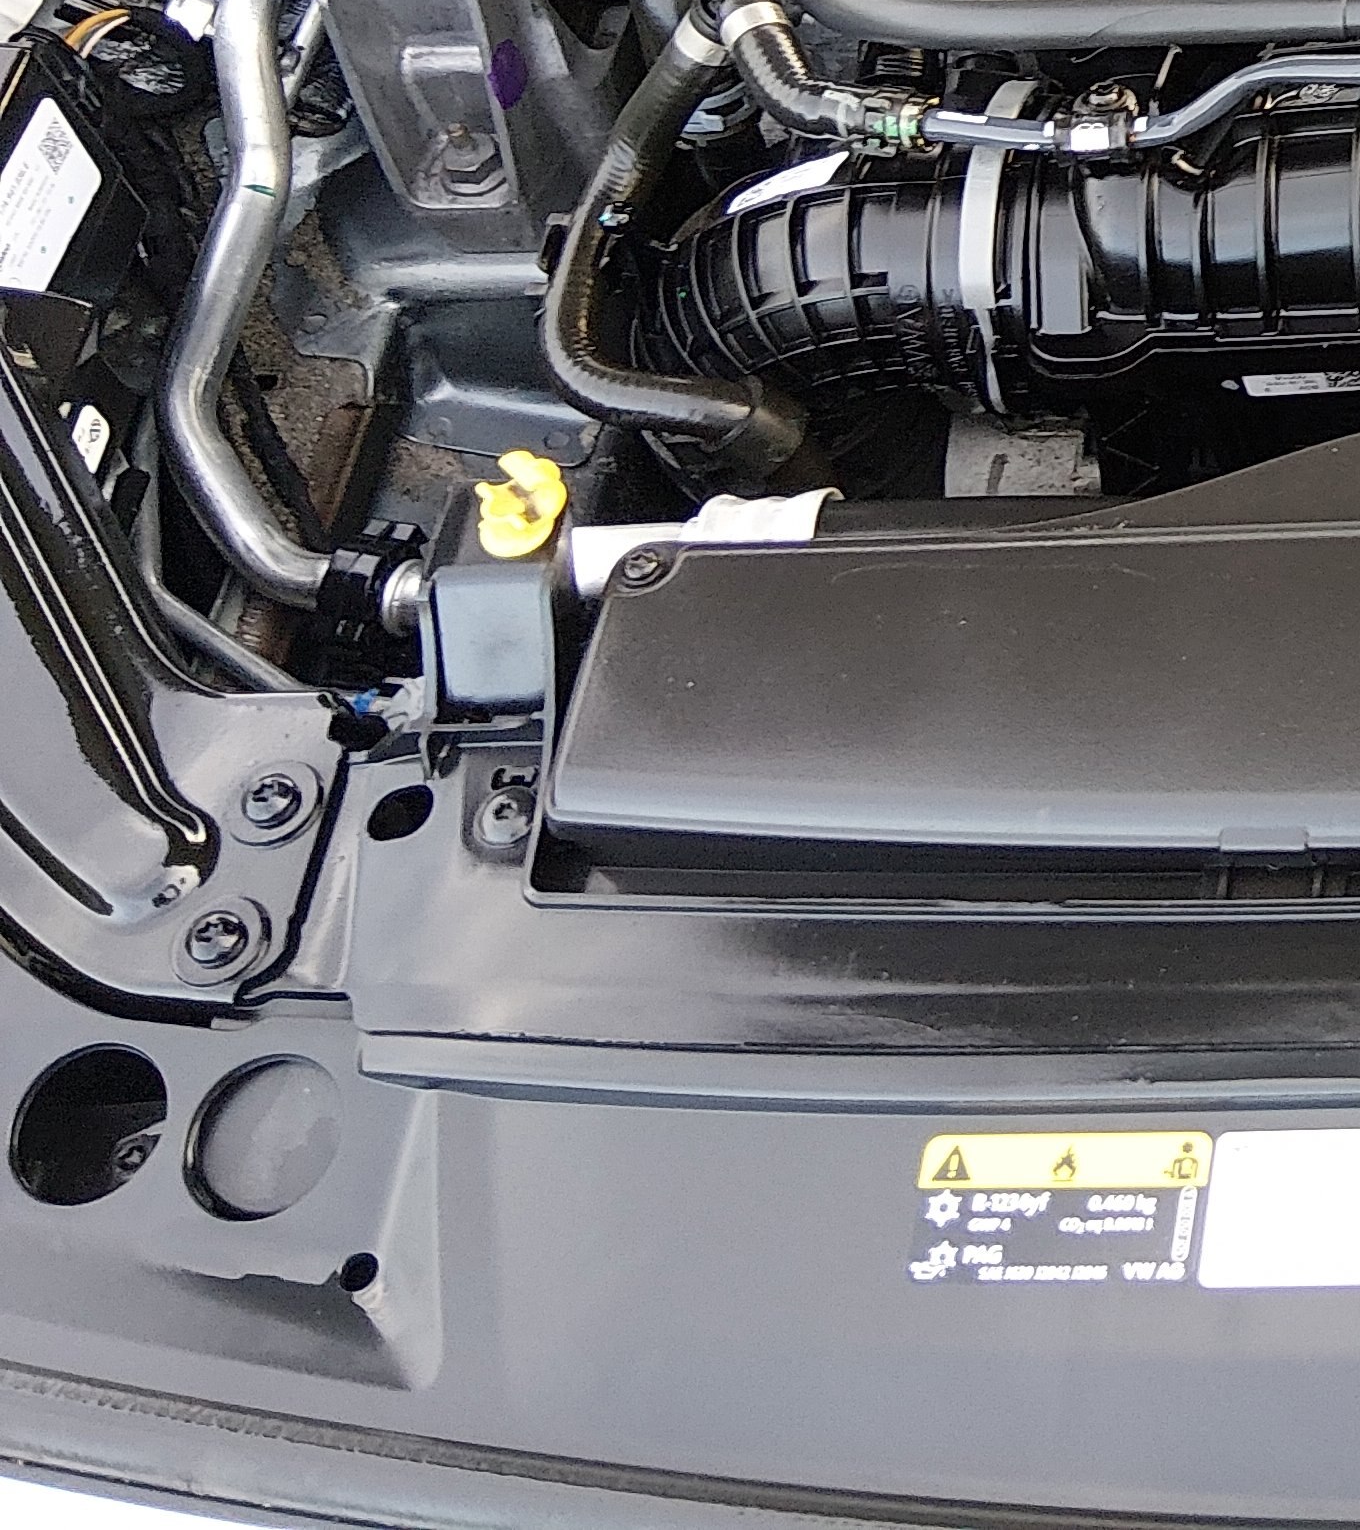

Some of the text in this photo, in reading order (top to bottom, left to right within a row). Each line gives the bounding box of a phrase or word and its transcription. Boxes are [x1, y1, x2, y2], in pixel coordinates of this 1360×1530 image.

[961, 1244, 1003, 1264] PAG
[1121, 1261, 1157, 1280] VW
[1155, 1261, 1186, 1280] AG
